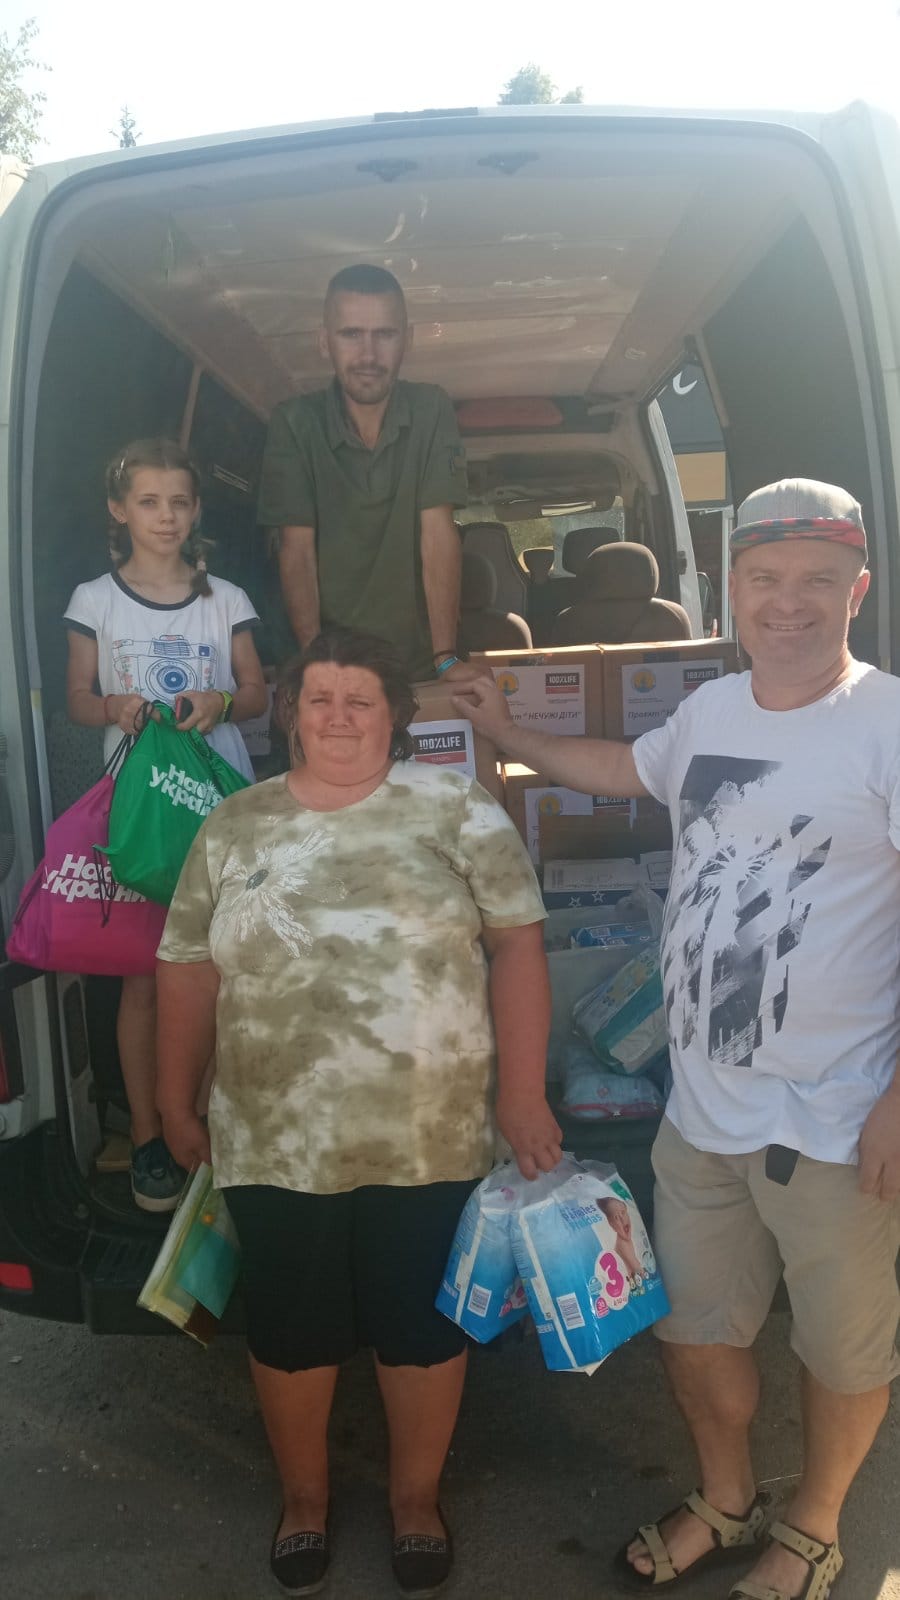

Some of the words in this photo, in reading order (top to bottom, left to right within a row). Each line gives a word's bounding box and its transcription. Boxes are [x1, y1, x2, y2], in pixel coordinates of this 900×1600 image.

[548, 674, 577, 684] 100%LIFE
[418, 735, 461, 750] 100%LIFE
[599, 1252, 625, 1298] 3
